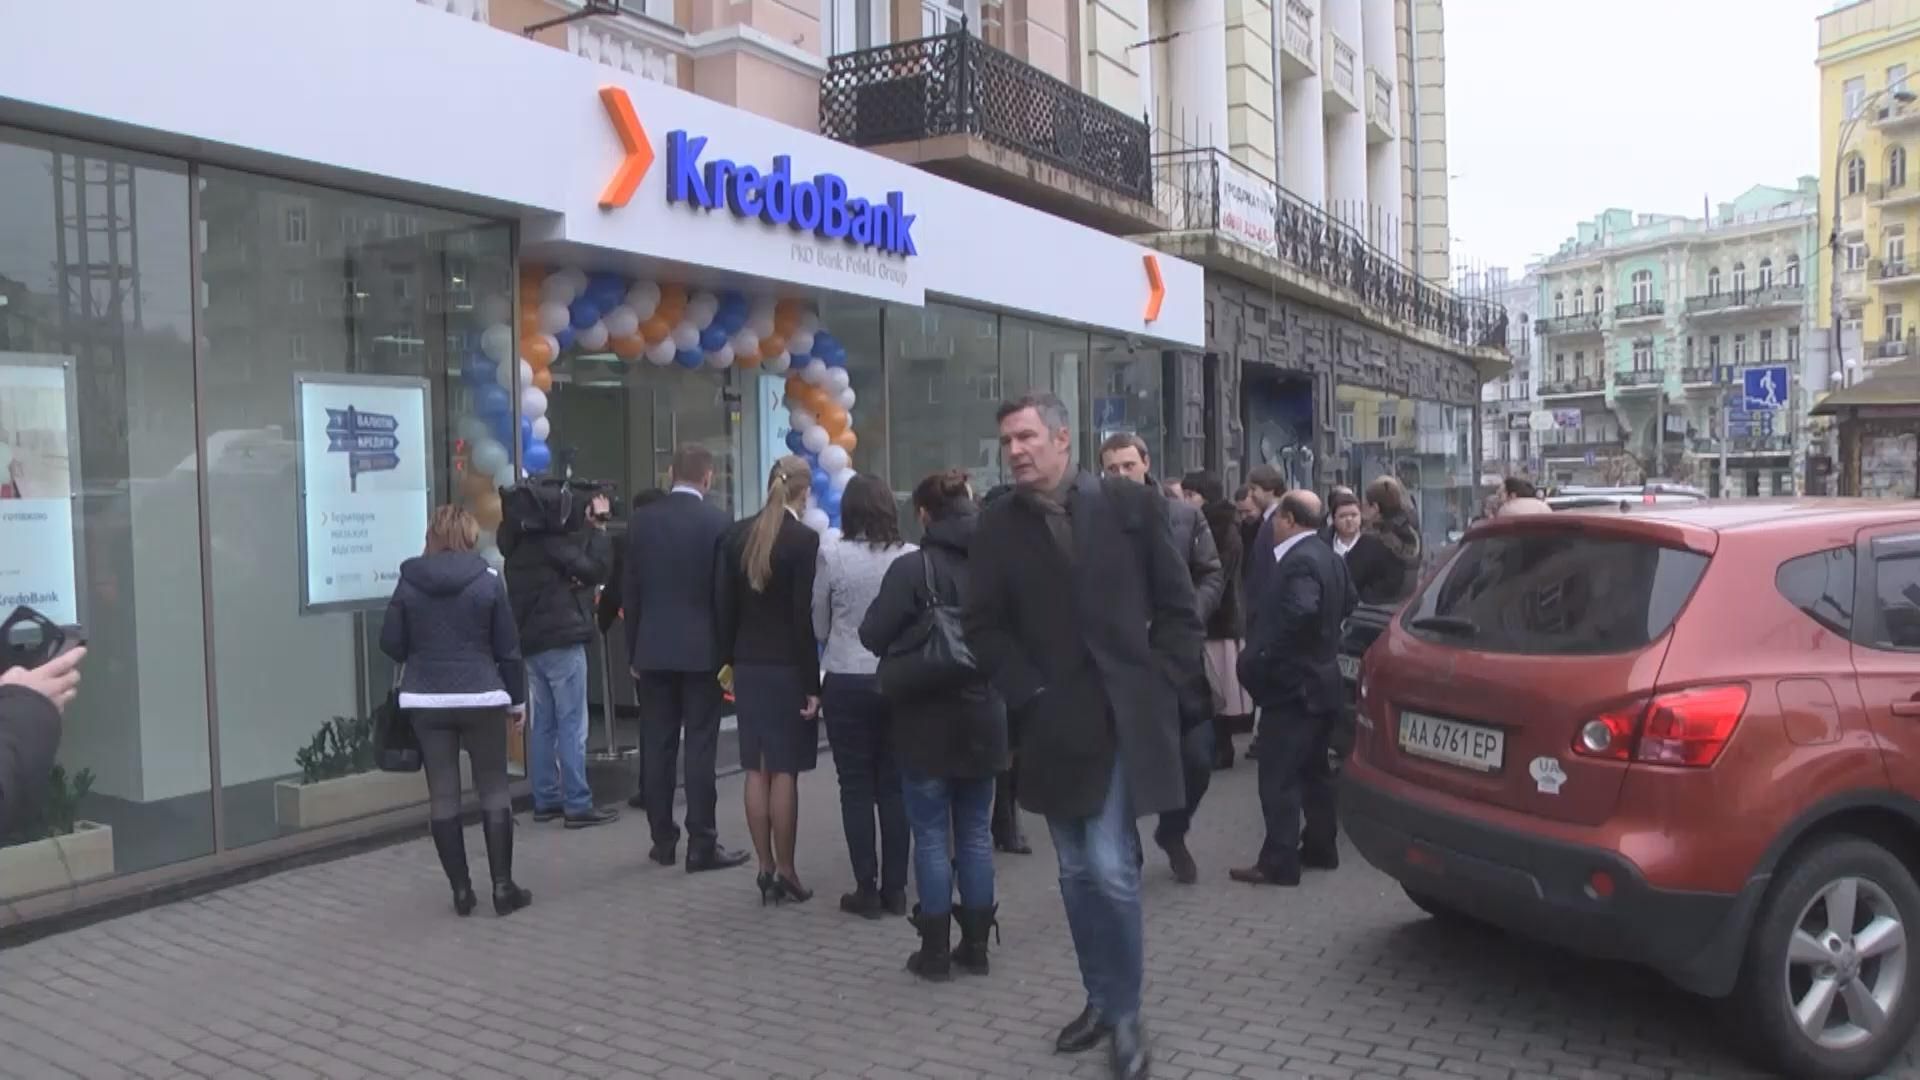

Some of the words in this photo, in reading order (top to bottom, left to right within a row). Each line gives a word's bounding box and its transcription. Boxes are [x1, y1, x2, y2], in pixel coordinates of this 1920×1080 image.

[666, 129, 917, 256] KredoBank
[817, 249, 844, 271] Bank
[846, 255, 876, 278] Polski
[878, 263, 908, 288] Group
[1408, 719, 1428, 746] AA
[1433, 724, 1468, 754] 6761
[1473, 734, 1497, 759] EP
[1539, 759, 1560, 773] UA
